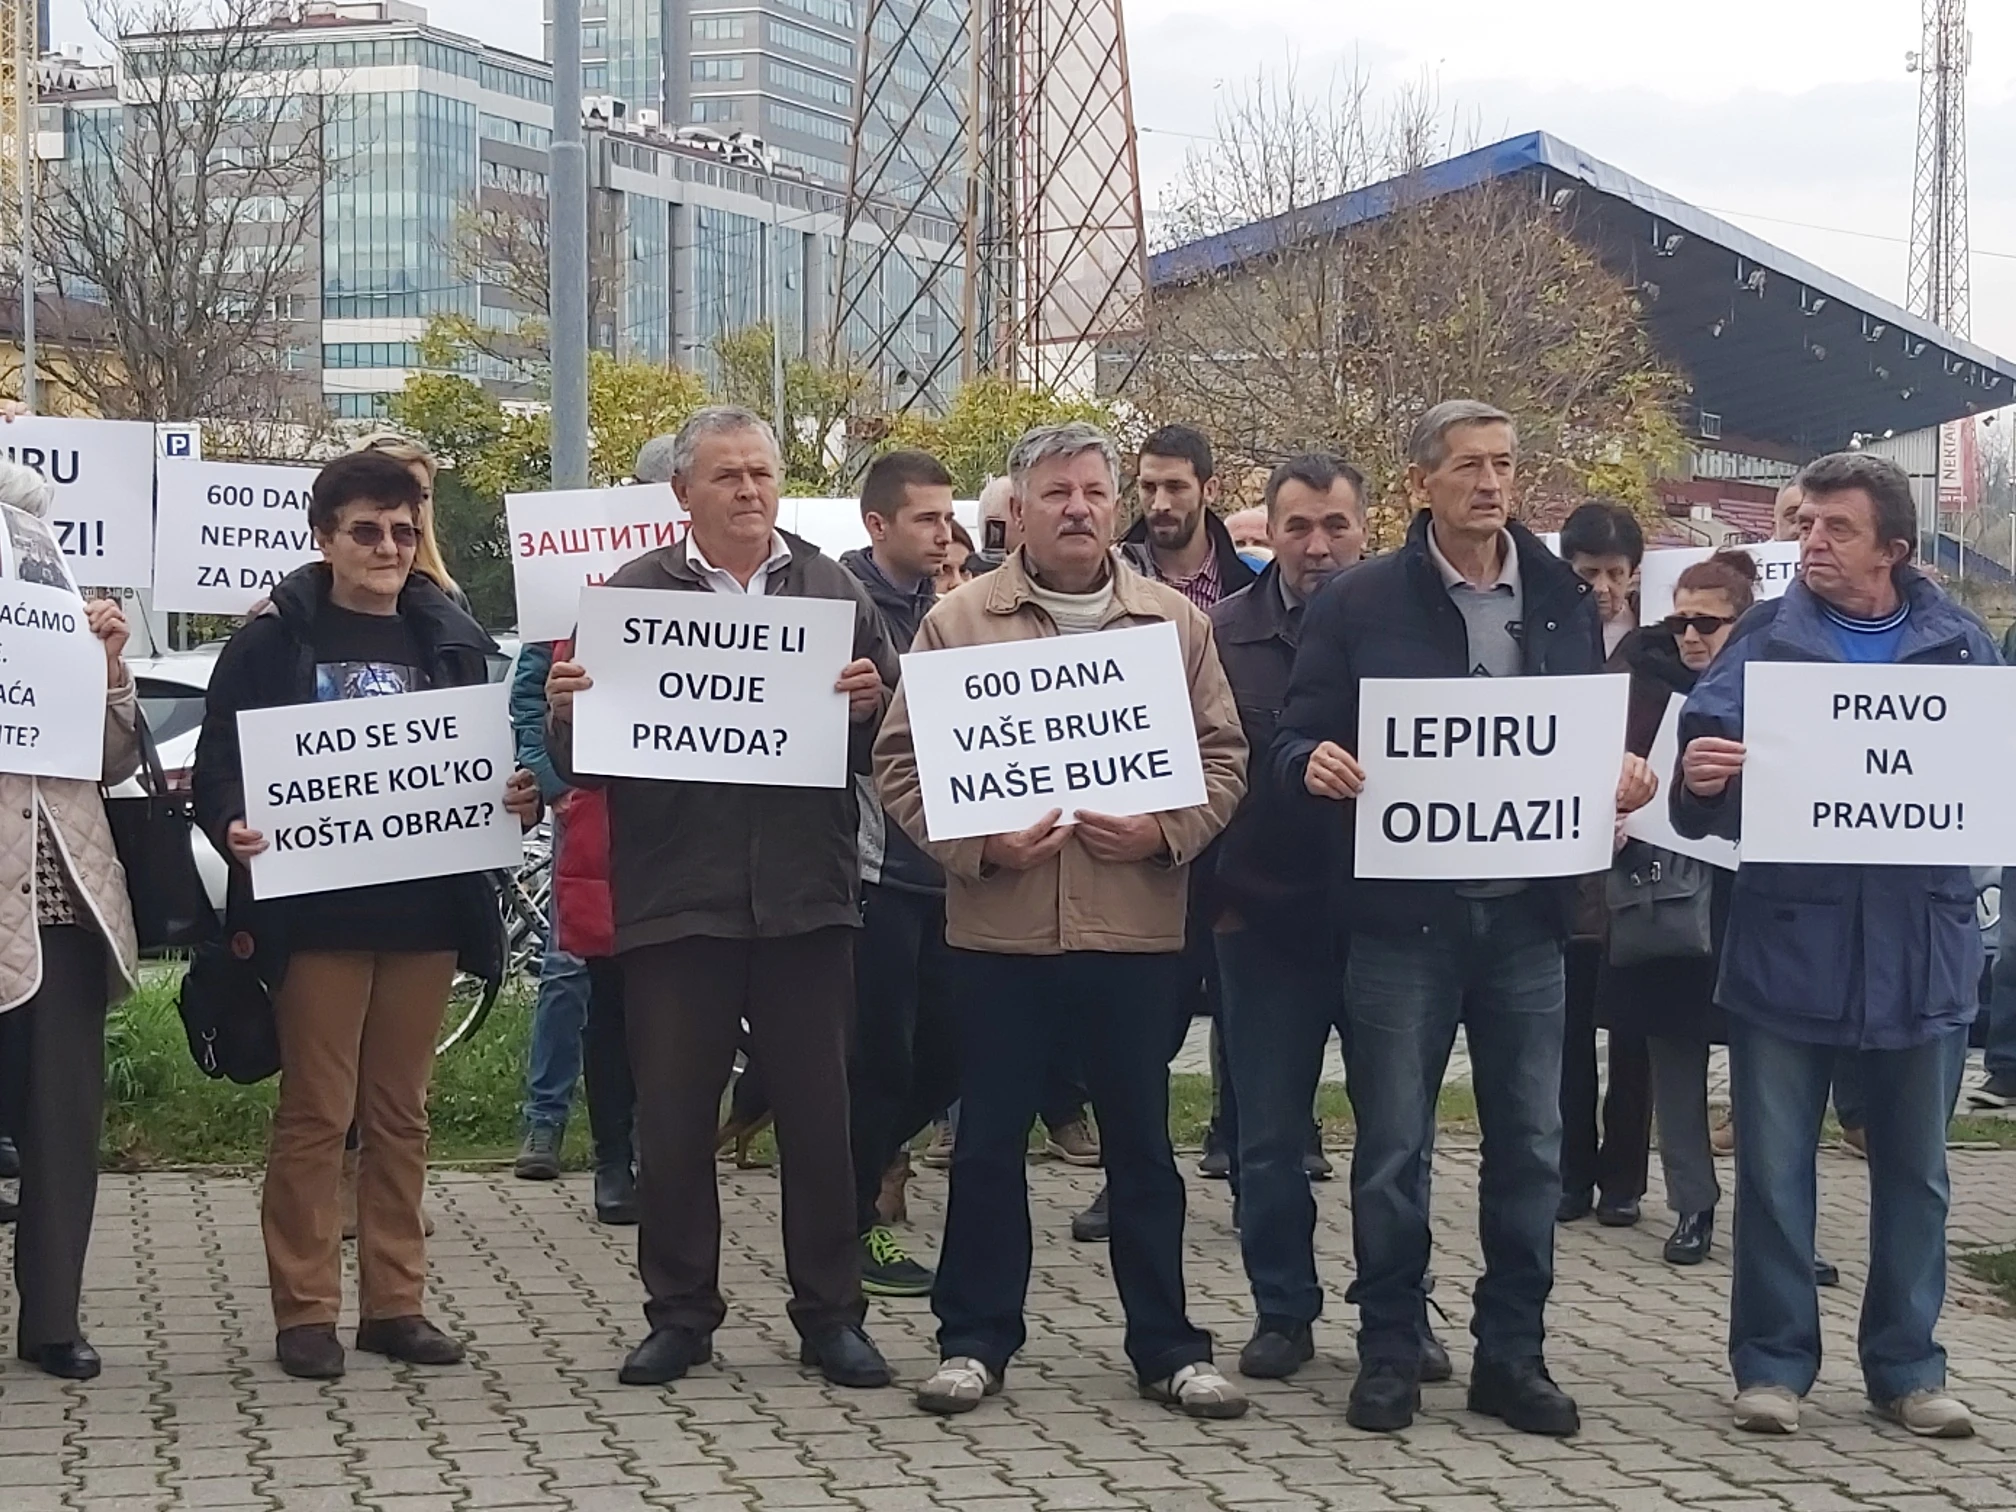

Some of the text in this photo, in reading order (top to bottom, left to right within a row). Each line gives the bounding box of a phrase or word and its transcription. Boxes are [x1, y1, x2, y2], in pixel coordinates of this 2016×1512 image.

[171, 436, 187, 455] P
[0, 446, 79, 484] IRU
[207, 484, 314, 510] 600 DAN
[53, 520, 104, 557] ZI!
[197, 566, 284, 589] ZA DA
[623, 617, 805, 653] STANUJE LI
[659, 671, 766, 703] OVDJE
[964, 658, 1125, 700] 600 DANA
[1833, 694, 1947, 722] PRAVO
[295, 715, 459, 757] KAD SE SVE
[633, 723, 788, 757] PRAVDA?
[952, 704, 1151, 752] VAŠE BRUKE
[1385, 714, 1557, 758] LEPIRU
[949, 749, 1173, 804] NAŠE BUKE
[1866, 748, 1913, 776] NA
[268, 771, 380, 807] SABERE
[275, 801, 495, 852] KOŠTA OBRAZ?
[1381, 795, 1581, 844] ODLAZI!
[1812, 801, 1964, 831] PRAVDU!
